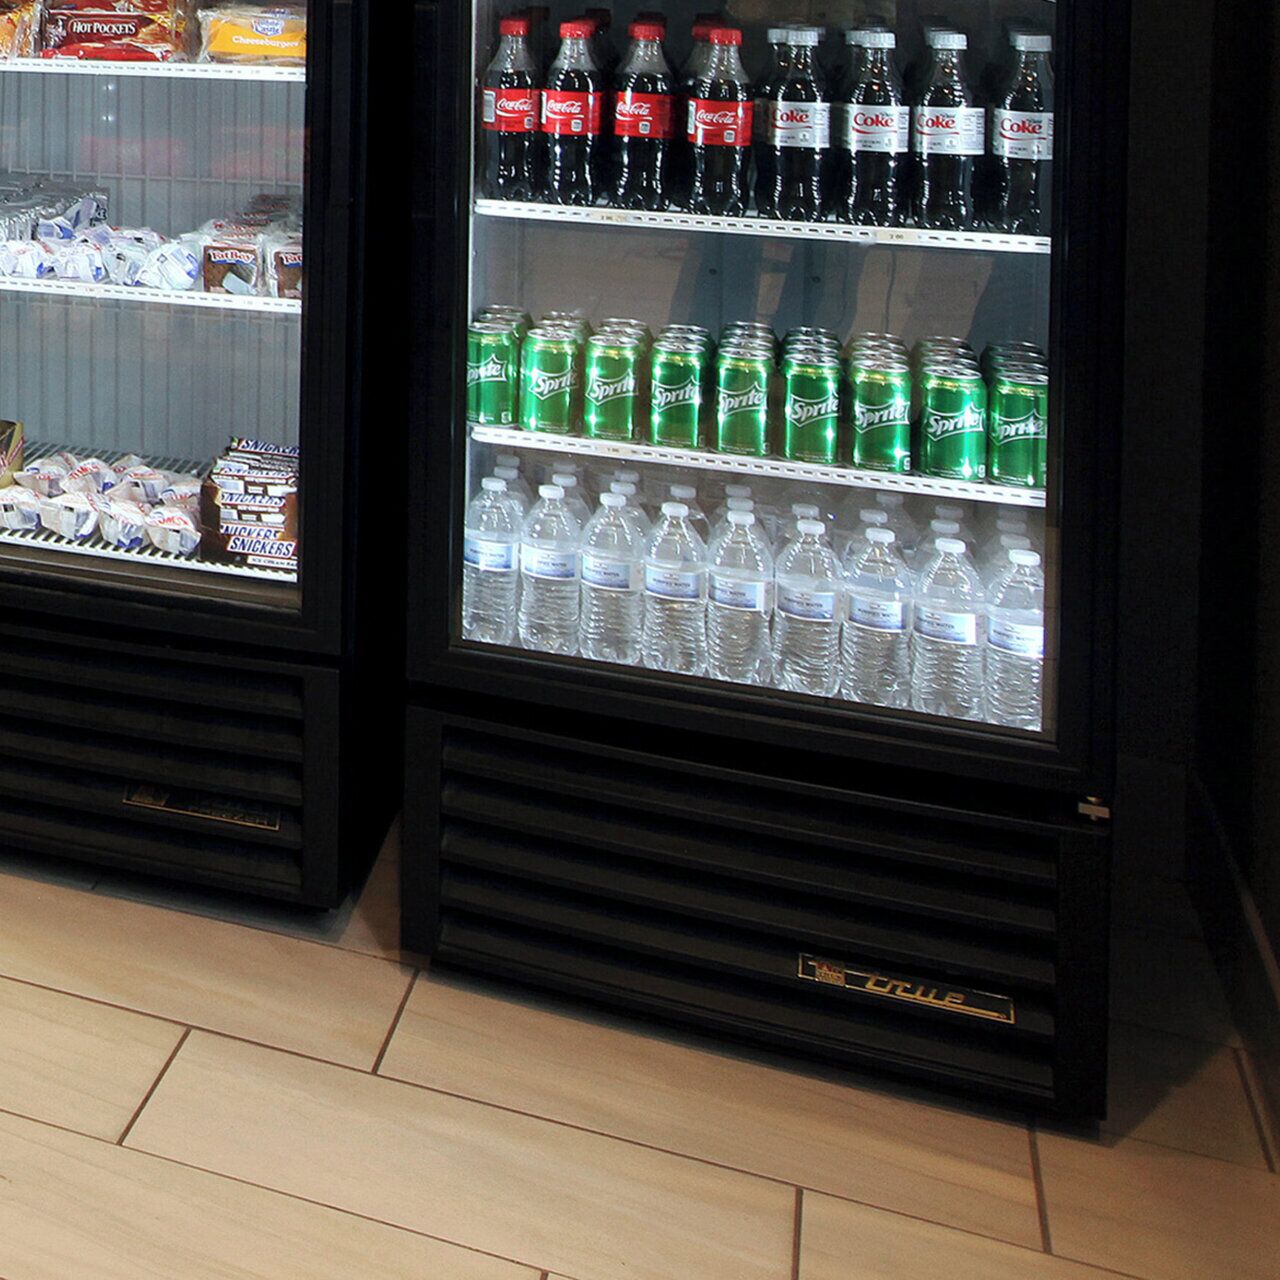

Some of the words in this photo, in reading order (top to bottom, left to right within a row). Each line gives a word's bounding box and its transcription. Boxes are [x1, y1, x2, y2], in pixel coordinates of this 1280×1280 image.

[72, 21, 91, 33] HOT
[93, 21, 136, 35] POCKETS
[853, 112, 895, 127] Coke
[917, 114, 956, 128] Coke
[1000, 118, 1043, 134] Coke
[467, 363, 502, 382] prite
[792, 394, 839, 421] Sprite
[230, 537, 293, 557] SNICKERS
